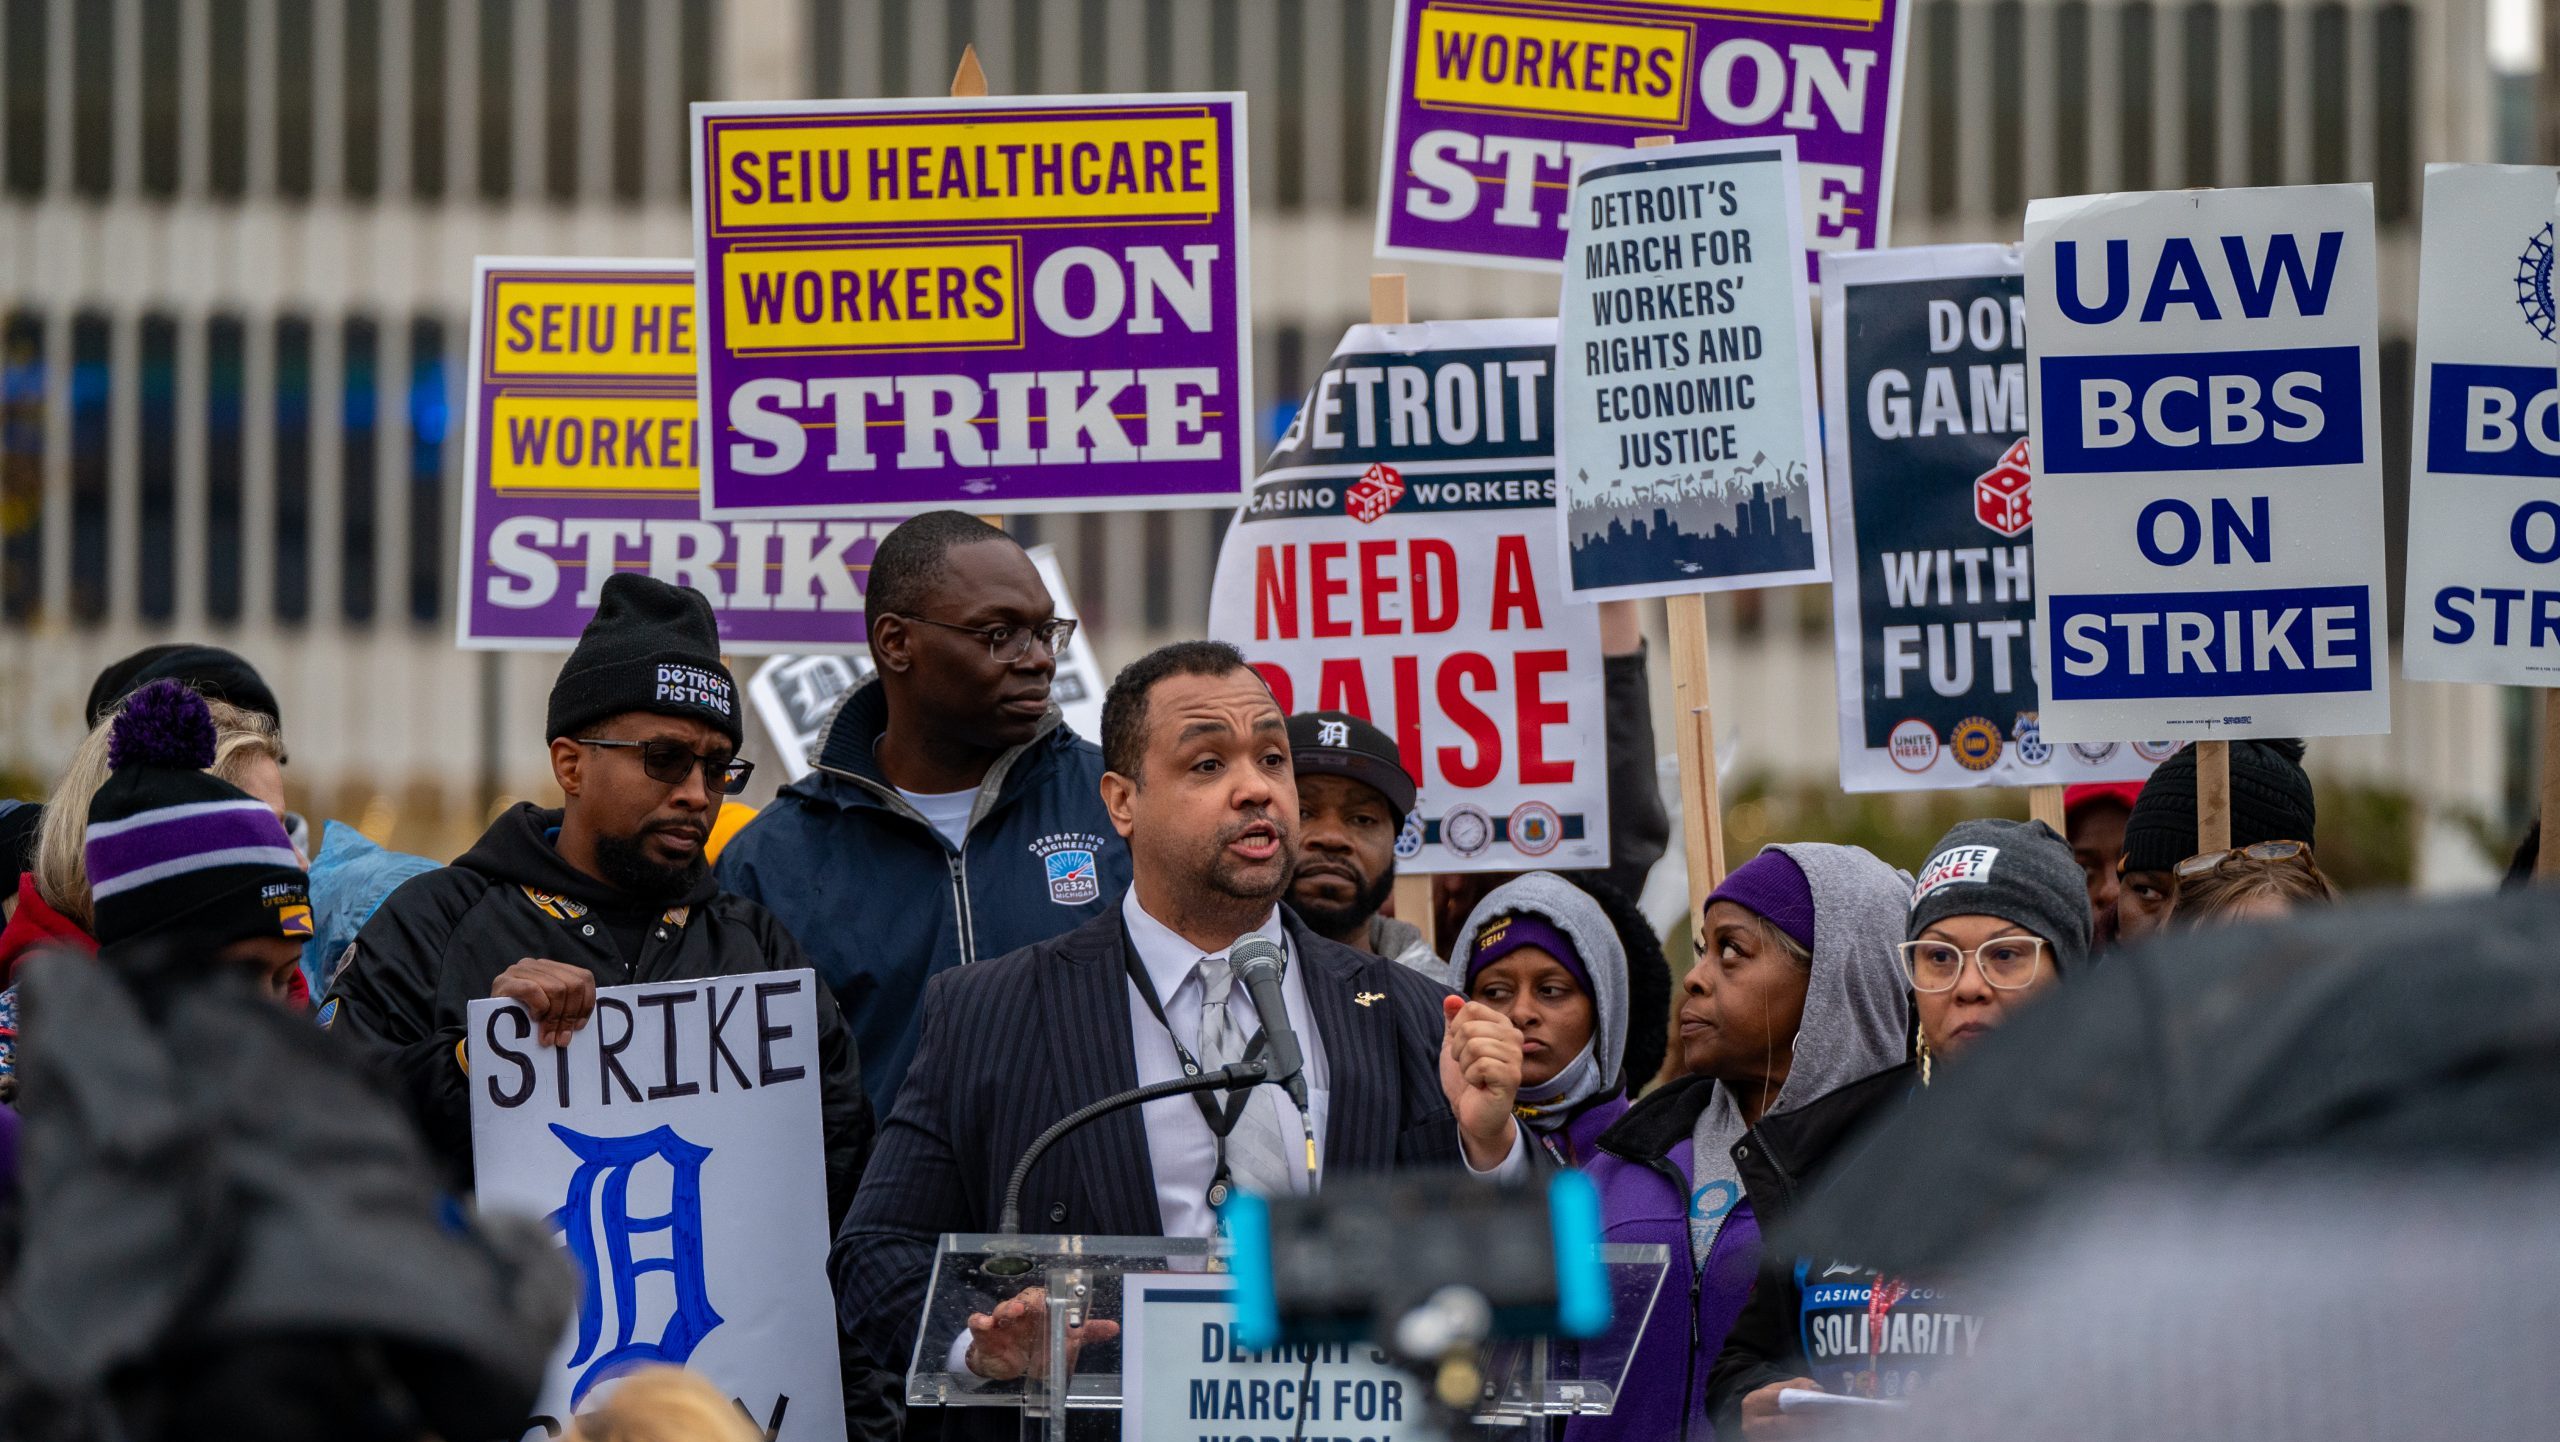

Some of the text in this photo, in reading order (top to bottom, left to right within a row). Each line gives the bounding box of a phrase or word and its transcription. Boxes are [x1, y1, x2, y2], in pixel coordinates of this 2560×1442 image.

[1434, 30, 1877, 134] WORKERS ON
[731, 139, 1207, 205] SEIU HEALTHCARE
[1406, 129, 1864, 251] STE
[1591, 180, 1739, 231] DETROIT'S
[1585, 229, 1752, 280] MARCH FOR
[2054, 231, 2345, 325] UAW
[740, 244, 1220, 338] WORKERS ON
[1592, 276, 1745, 326] WORKERS'
[506, 303, 616, 355] SEIU
[1585, 325, 1763, 376] RIGHTS AND
[728, 367, 1223, 476] STRIKE
[1596, 374, 1756, 424] ECONOMIC
[1867, 363, 2028, 440] GAM
[2080, 370, 2326, 448] BCBS
[2466, 385, 2559, 457] BC
[508, 416, 698, 468] WORKE
[1618, 424, 1738, 470] JUSTICE
[1249, 478, 1557, 514] CASINO WORKERS
[2136, 496, 2272, 567] ON
[2509, 499, 2560, 564] O
[487, 515, 899, 610] STRIK
[1254, 534, 1544, 641] NEED A
[1881, 545, 2031, 608] WITH
[2062, 605, 2357, 677] STRIKE
[2432, 585, 2560, 648] STR
[1883, 619, 2039, 699] FUT
[1894, 734, 1932, 746] UNITE
[1028, 832, 1105, 852] OPERATING
[1036, 841, 1099, 857] ENGINEERS
[1920, 849, 1988, 883] UNITE
[261, 883, 287, 898] SEIU
[1054, 880, 1093, 892] OE324
[1056, 890, 1094, 899] MICHIGAN
[1913, 862, 1979, 902] HERE!
[1480, 930, 1506, 951] SEIU
[1814, 1289, 1873, 1303] CASINO
[1812, 1312, 1985, 1358] SOLIDARITY
[1189, 1379, 1403, 1422] MARCH FOR
